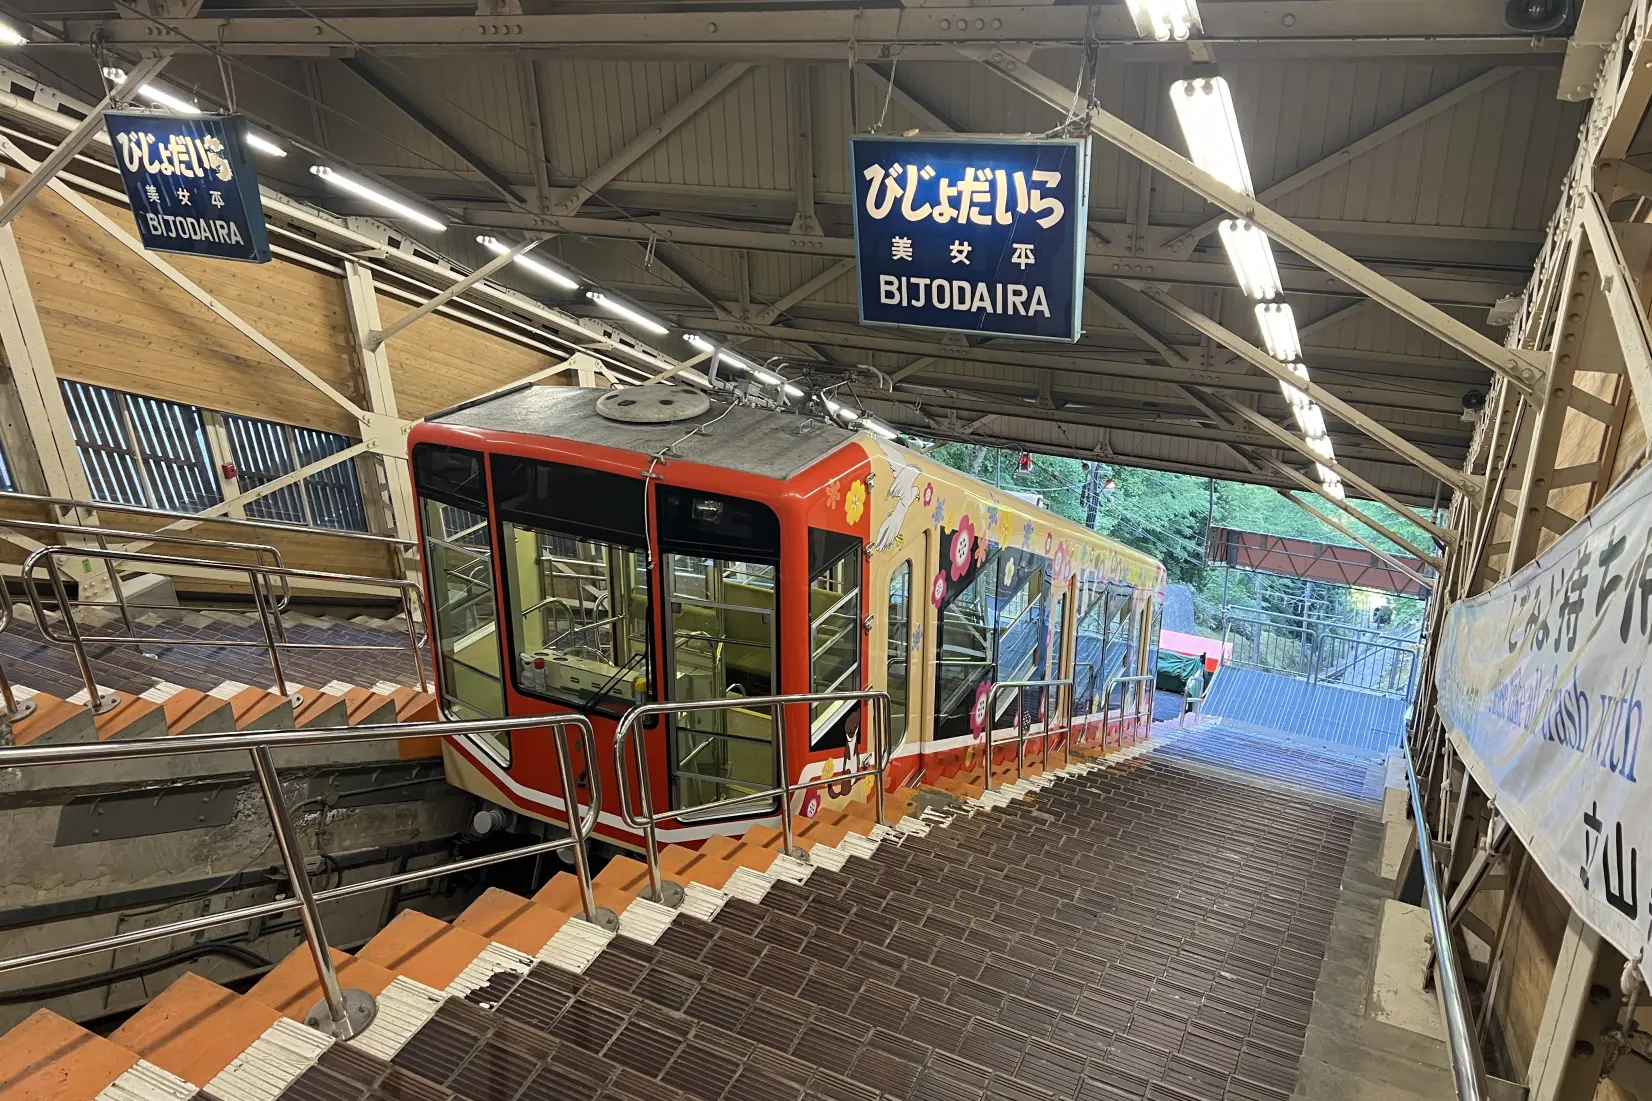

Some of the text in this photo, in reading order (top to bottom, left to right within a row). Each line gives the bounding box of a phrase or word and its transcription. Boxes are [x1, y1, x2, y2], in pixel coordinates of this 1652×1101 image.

[116, 131, 233, 181] びじょだいら
[863, 162, 1065, 229] びじょだいら
[146, 213, 244, 246] BIJODAIRA
[879, 274, 1051, 318] BIJODAIRA
[1590, 663, 1643, 783] with
[1580, 800, 1652, 942] 立山
